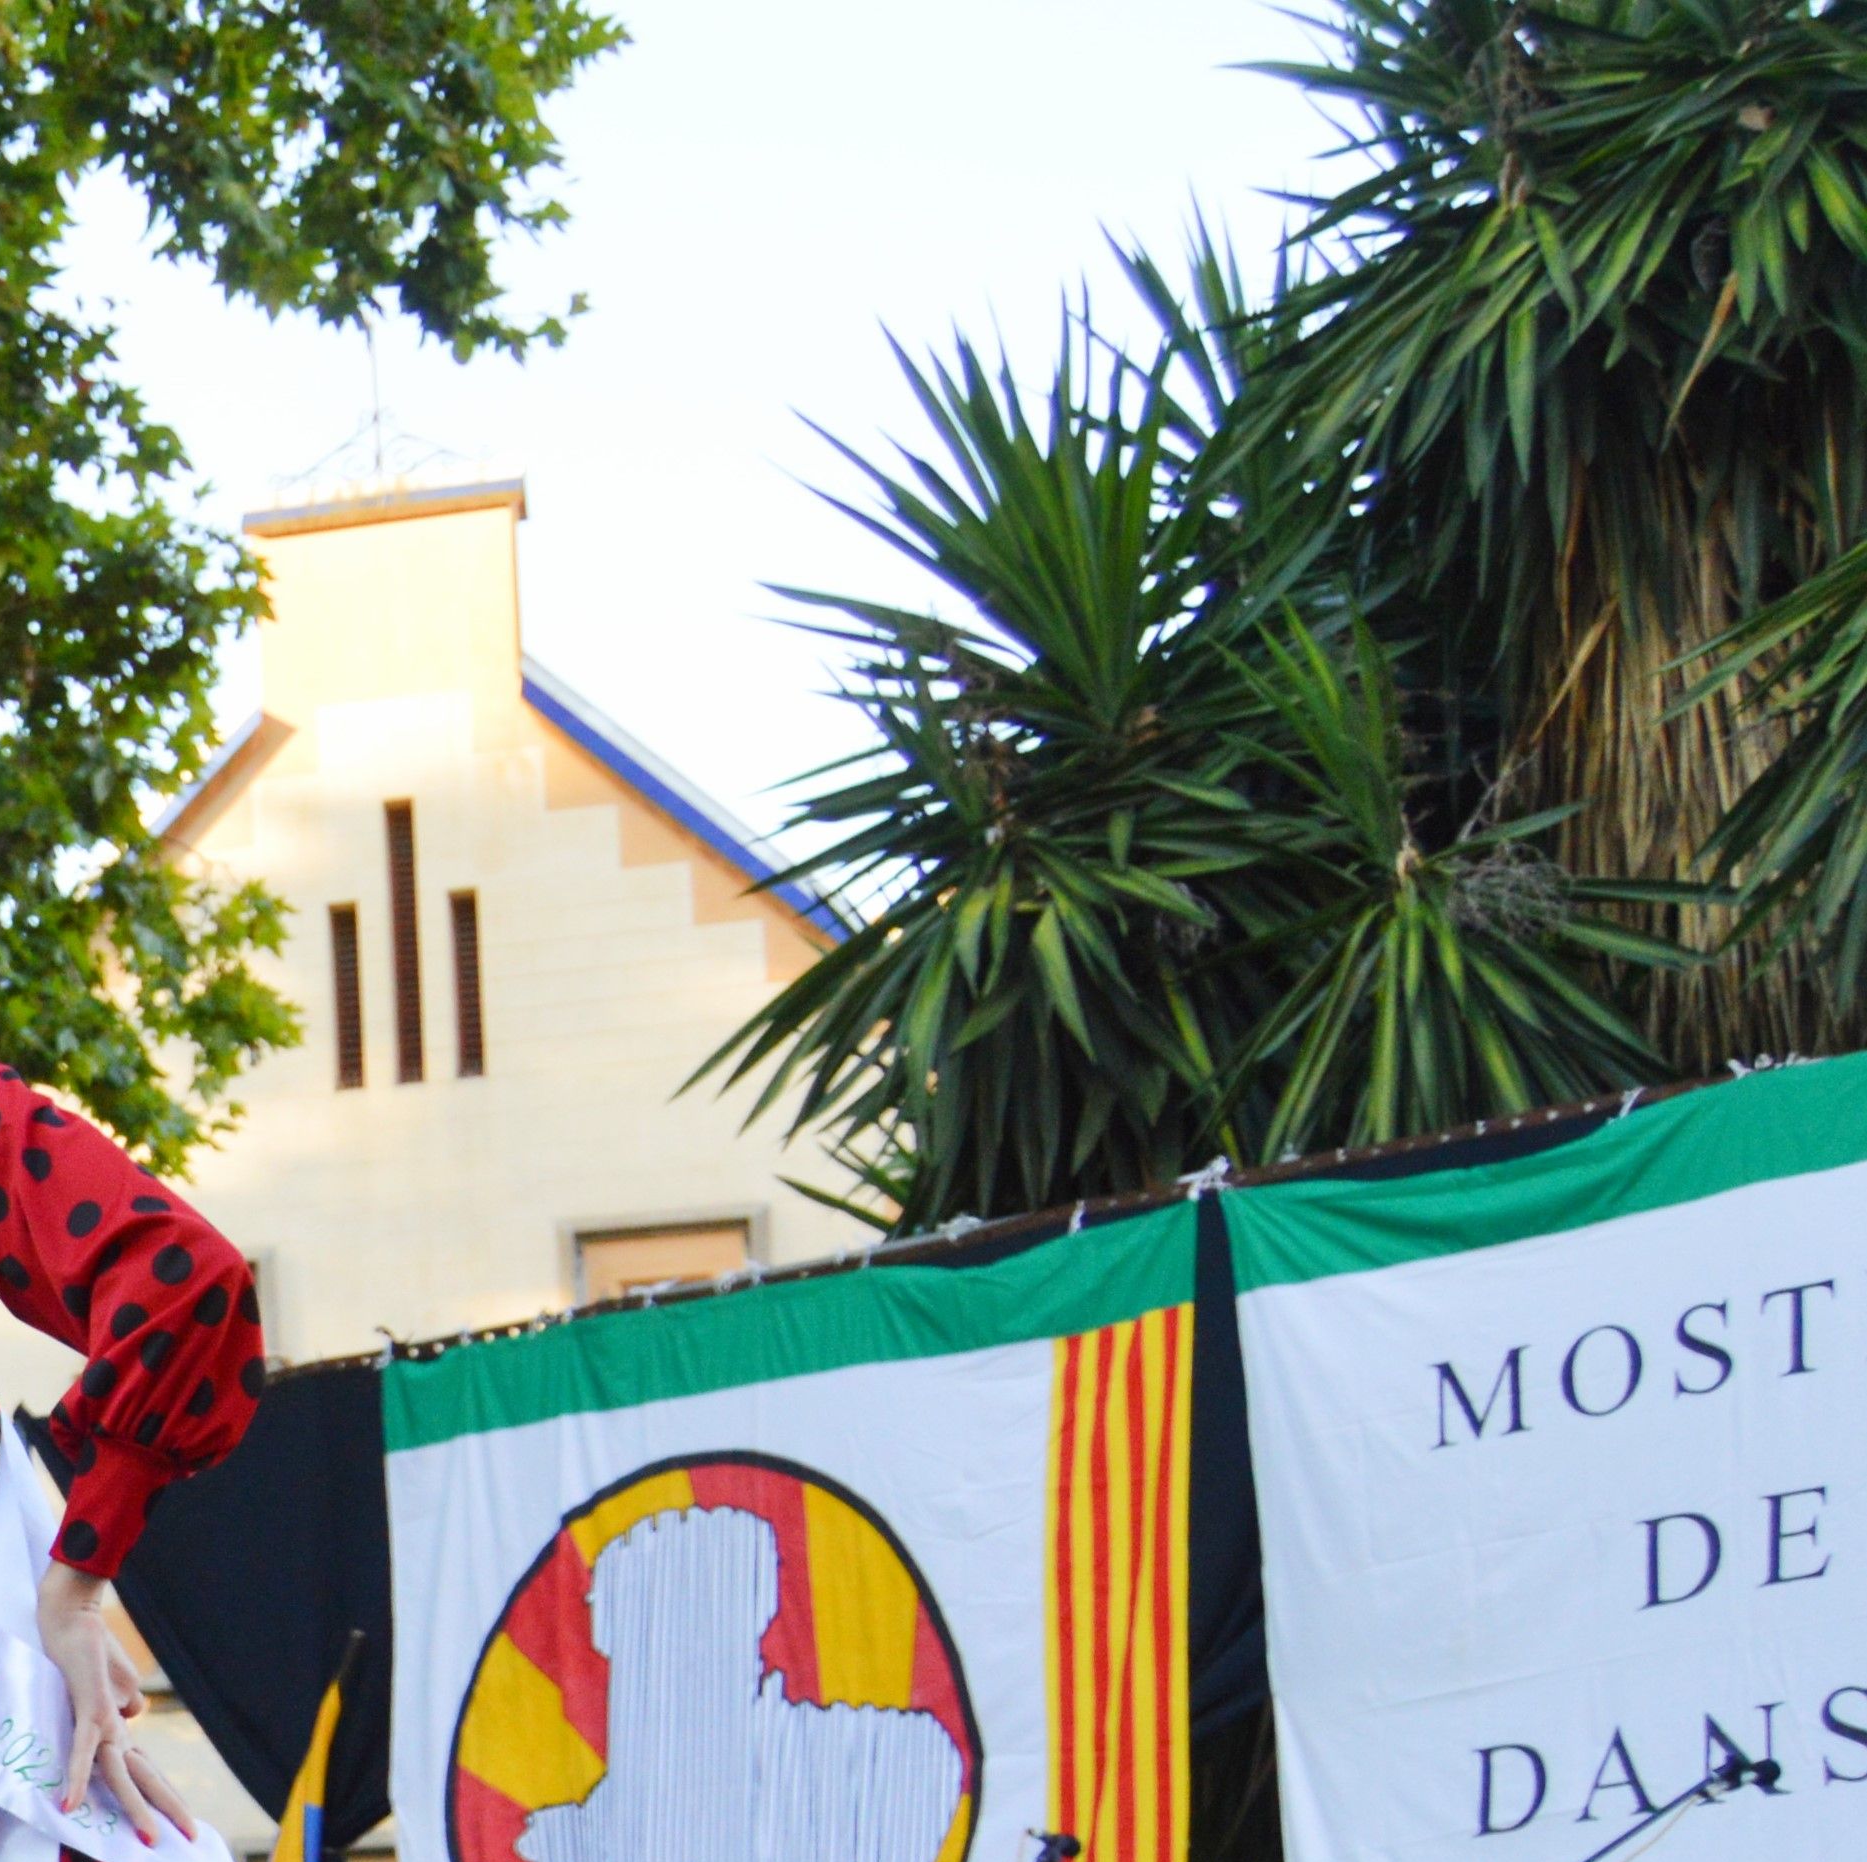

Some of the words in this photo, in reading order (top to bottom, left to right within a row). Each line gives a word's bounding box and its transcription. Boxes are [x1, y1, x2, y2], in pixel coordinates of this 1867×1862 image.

[1429, 1279, 1836, 1451] MOST
[1634, 1485, 1832, 1611] DE
[1471, 1686, 1867, 1838] DANS
